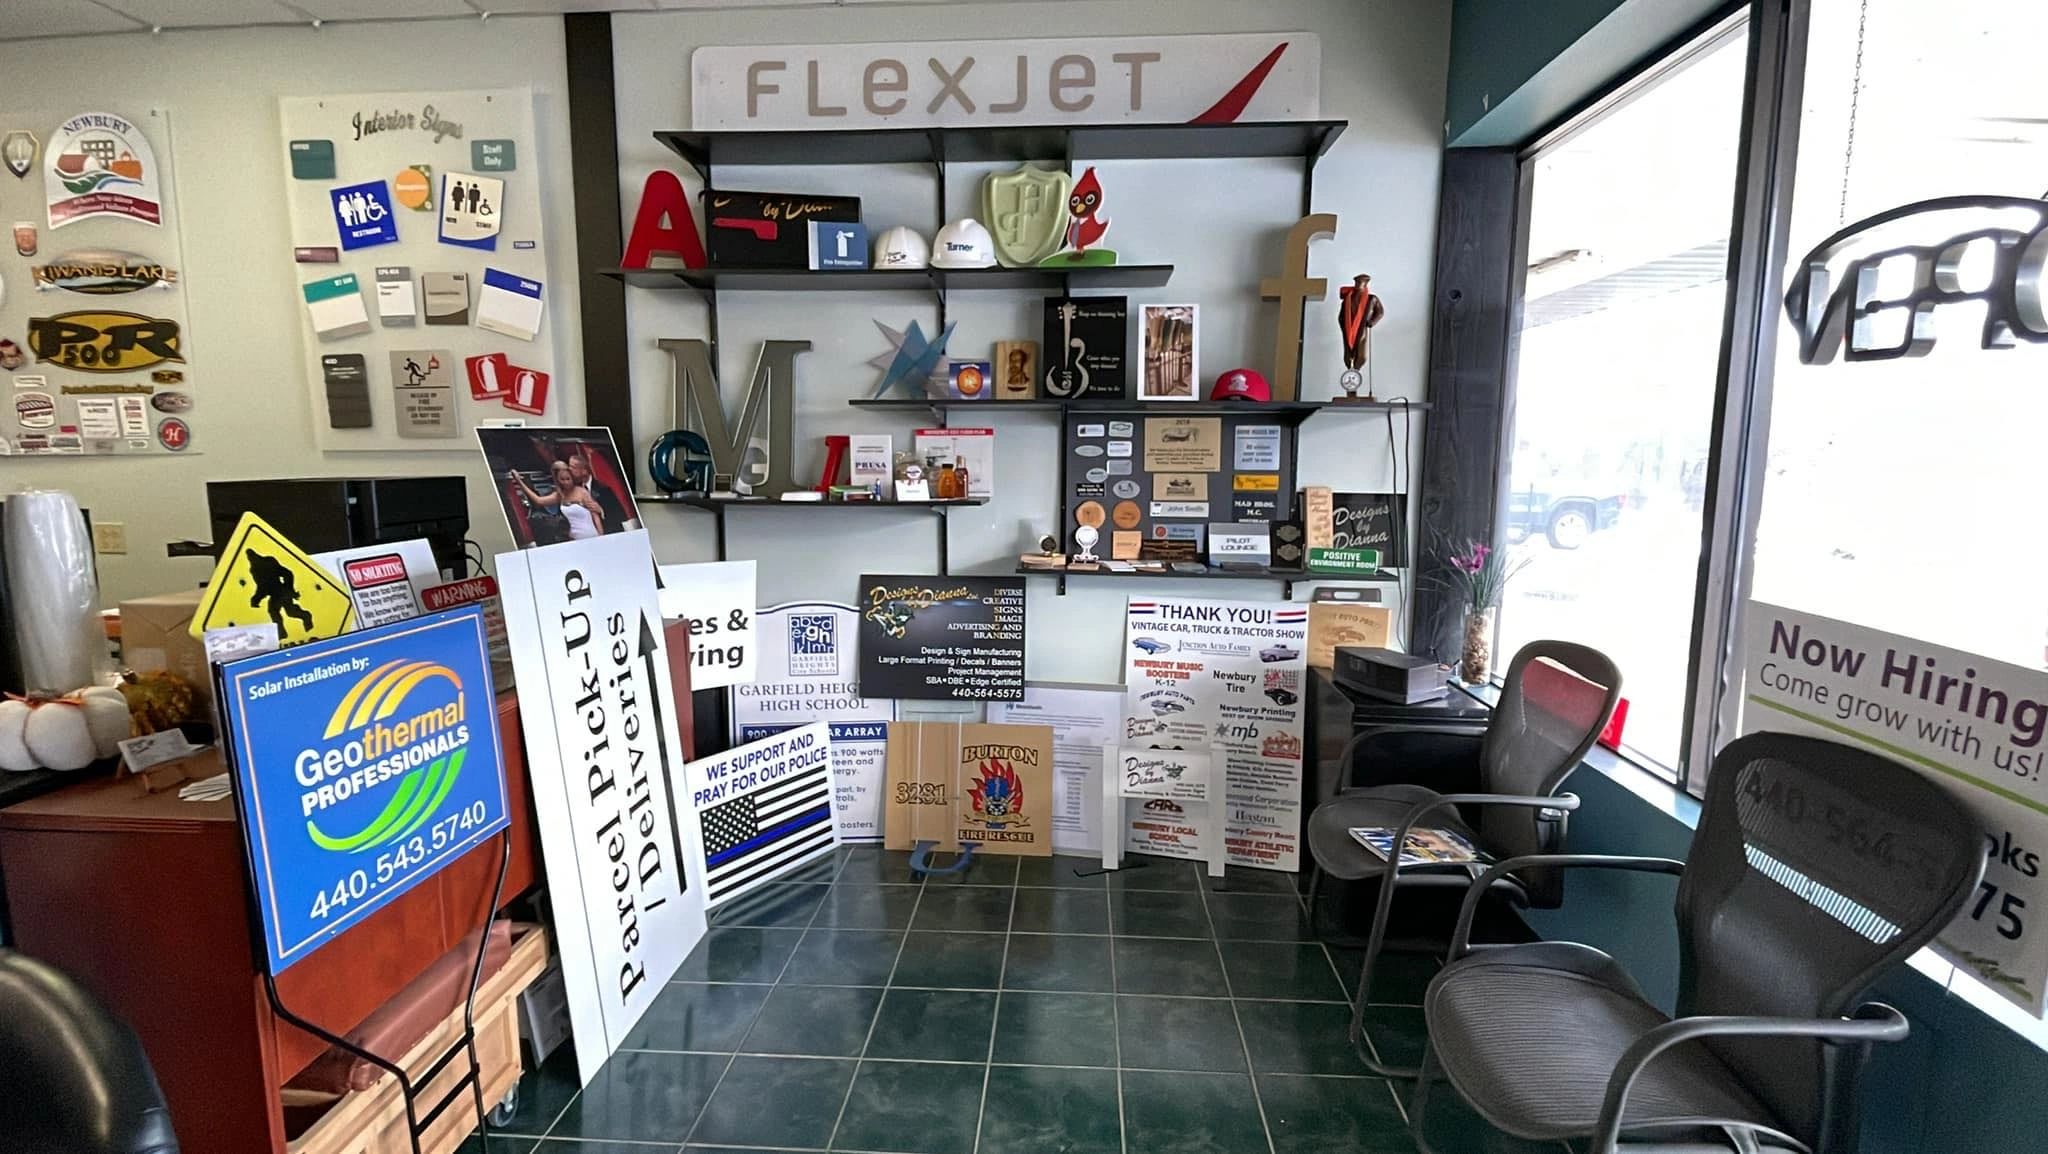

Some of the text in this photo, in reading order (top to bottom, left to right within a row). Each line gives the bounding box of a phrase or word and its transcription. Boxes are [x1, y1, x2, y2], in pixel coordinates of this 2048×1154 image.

[63, 115, 132, 136] NEWBURY
[352, 104, 463, 145] Interior Signs
[482, 144, 502, 154] Staff
[484, 156, 502, 168] Only
[621, 169, 708, 271] A
[946, 242, 974, 252] Turner
[32, 265, 178, 285] KIWANIS LAKE
[1260, 213, 1338, 400] f
[62, 344, 122, 367] 500
[658, 338, 812, 496] M
[1333, 504, 1389, 526] Designs
[1356, 522, 1370, 534] by
[1333, 530, 1389, 550] Dianna
[1310, 560, 1356, 568] ENVIRONMENT
[1323, 551, 1360, 561] POSITIVE
[363, 563, 404, 580] SOLICITING
[431, 582, 488, 608] WARNING
[870, 586, 918, 606] Designs
[994, 588, 1024, 596] DIVERSE
[982, 597, 1024, 606] CREATIVE
[994, 606, 1024, 614] SIGNS
[1160, 604, 1272, 624] THANK YOU!
[727, 609, 749, 631] &
[974, 632, 1022, 640] BRANDING
[1132, 622, 1305, 640] VINTAGE CAR, TRUCK & TRACTOR SHOW
[920, 646, 947, 656] Design
[955, 648, 972, 656] Sign
[973, 648, 1022, 658] Manufacturing
[878, 656, 899, 665] Large
[900, 656, 926, 664] Format
[927, 656, 954, 666] Printing
[960, 657, 986, 666] Decals
[992, 658, 1022, 666] Banners
[1134, 660, 1204, 672] NEWBURY MUSIC
[249, 656, 370, 700] Solar Installation by:
[948, 667, 1022, 677] Project Management
[1146, 670, 1190, 680] BOOSTERS
[1213, 670, 1256, 683] Newbury
[740, 682, 860, 697] GARFIELD HEIG
[970, 678, 1022, 686] Edge Certified
[1226, 683, 1246, 694] Tire
[1770, 620, 2048, 748] Now Hiring
[760, 698, 869, 712] HIGH SCHOOL
[1220, 704, 1296, 718] Newbury Printing
[1760, 662, 2044, 782] Come grow with us!
[294, 691, 466, 787] Geothermal
[844, 726, 882, 737] ARRAY
[606, 610, 663, 885] Deliveries
[840, 748, 884, 757] 900 watts
[962, 744, 1038, 766] BURTON
[706, 732, 814, 782] WE SUPPORT AND
[856, 758, 874, 766] and
[1126, 756, 1164, 772] Designs
[301, 725, 469, 817] PROFESSIONALS
[694, 746, 828, 808] PRAY FOR OUR POLICE
[561, 567, 647, 1007] Parcel Pick-Up
[896, 782, 948, 806] 3281
[958, 829, 1034, 842] FIRE RESCUE
[1172, 826, 1198, 836] LOCAL
[309, 800, 486, 919] 440.543.5740
